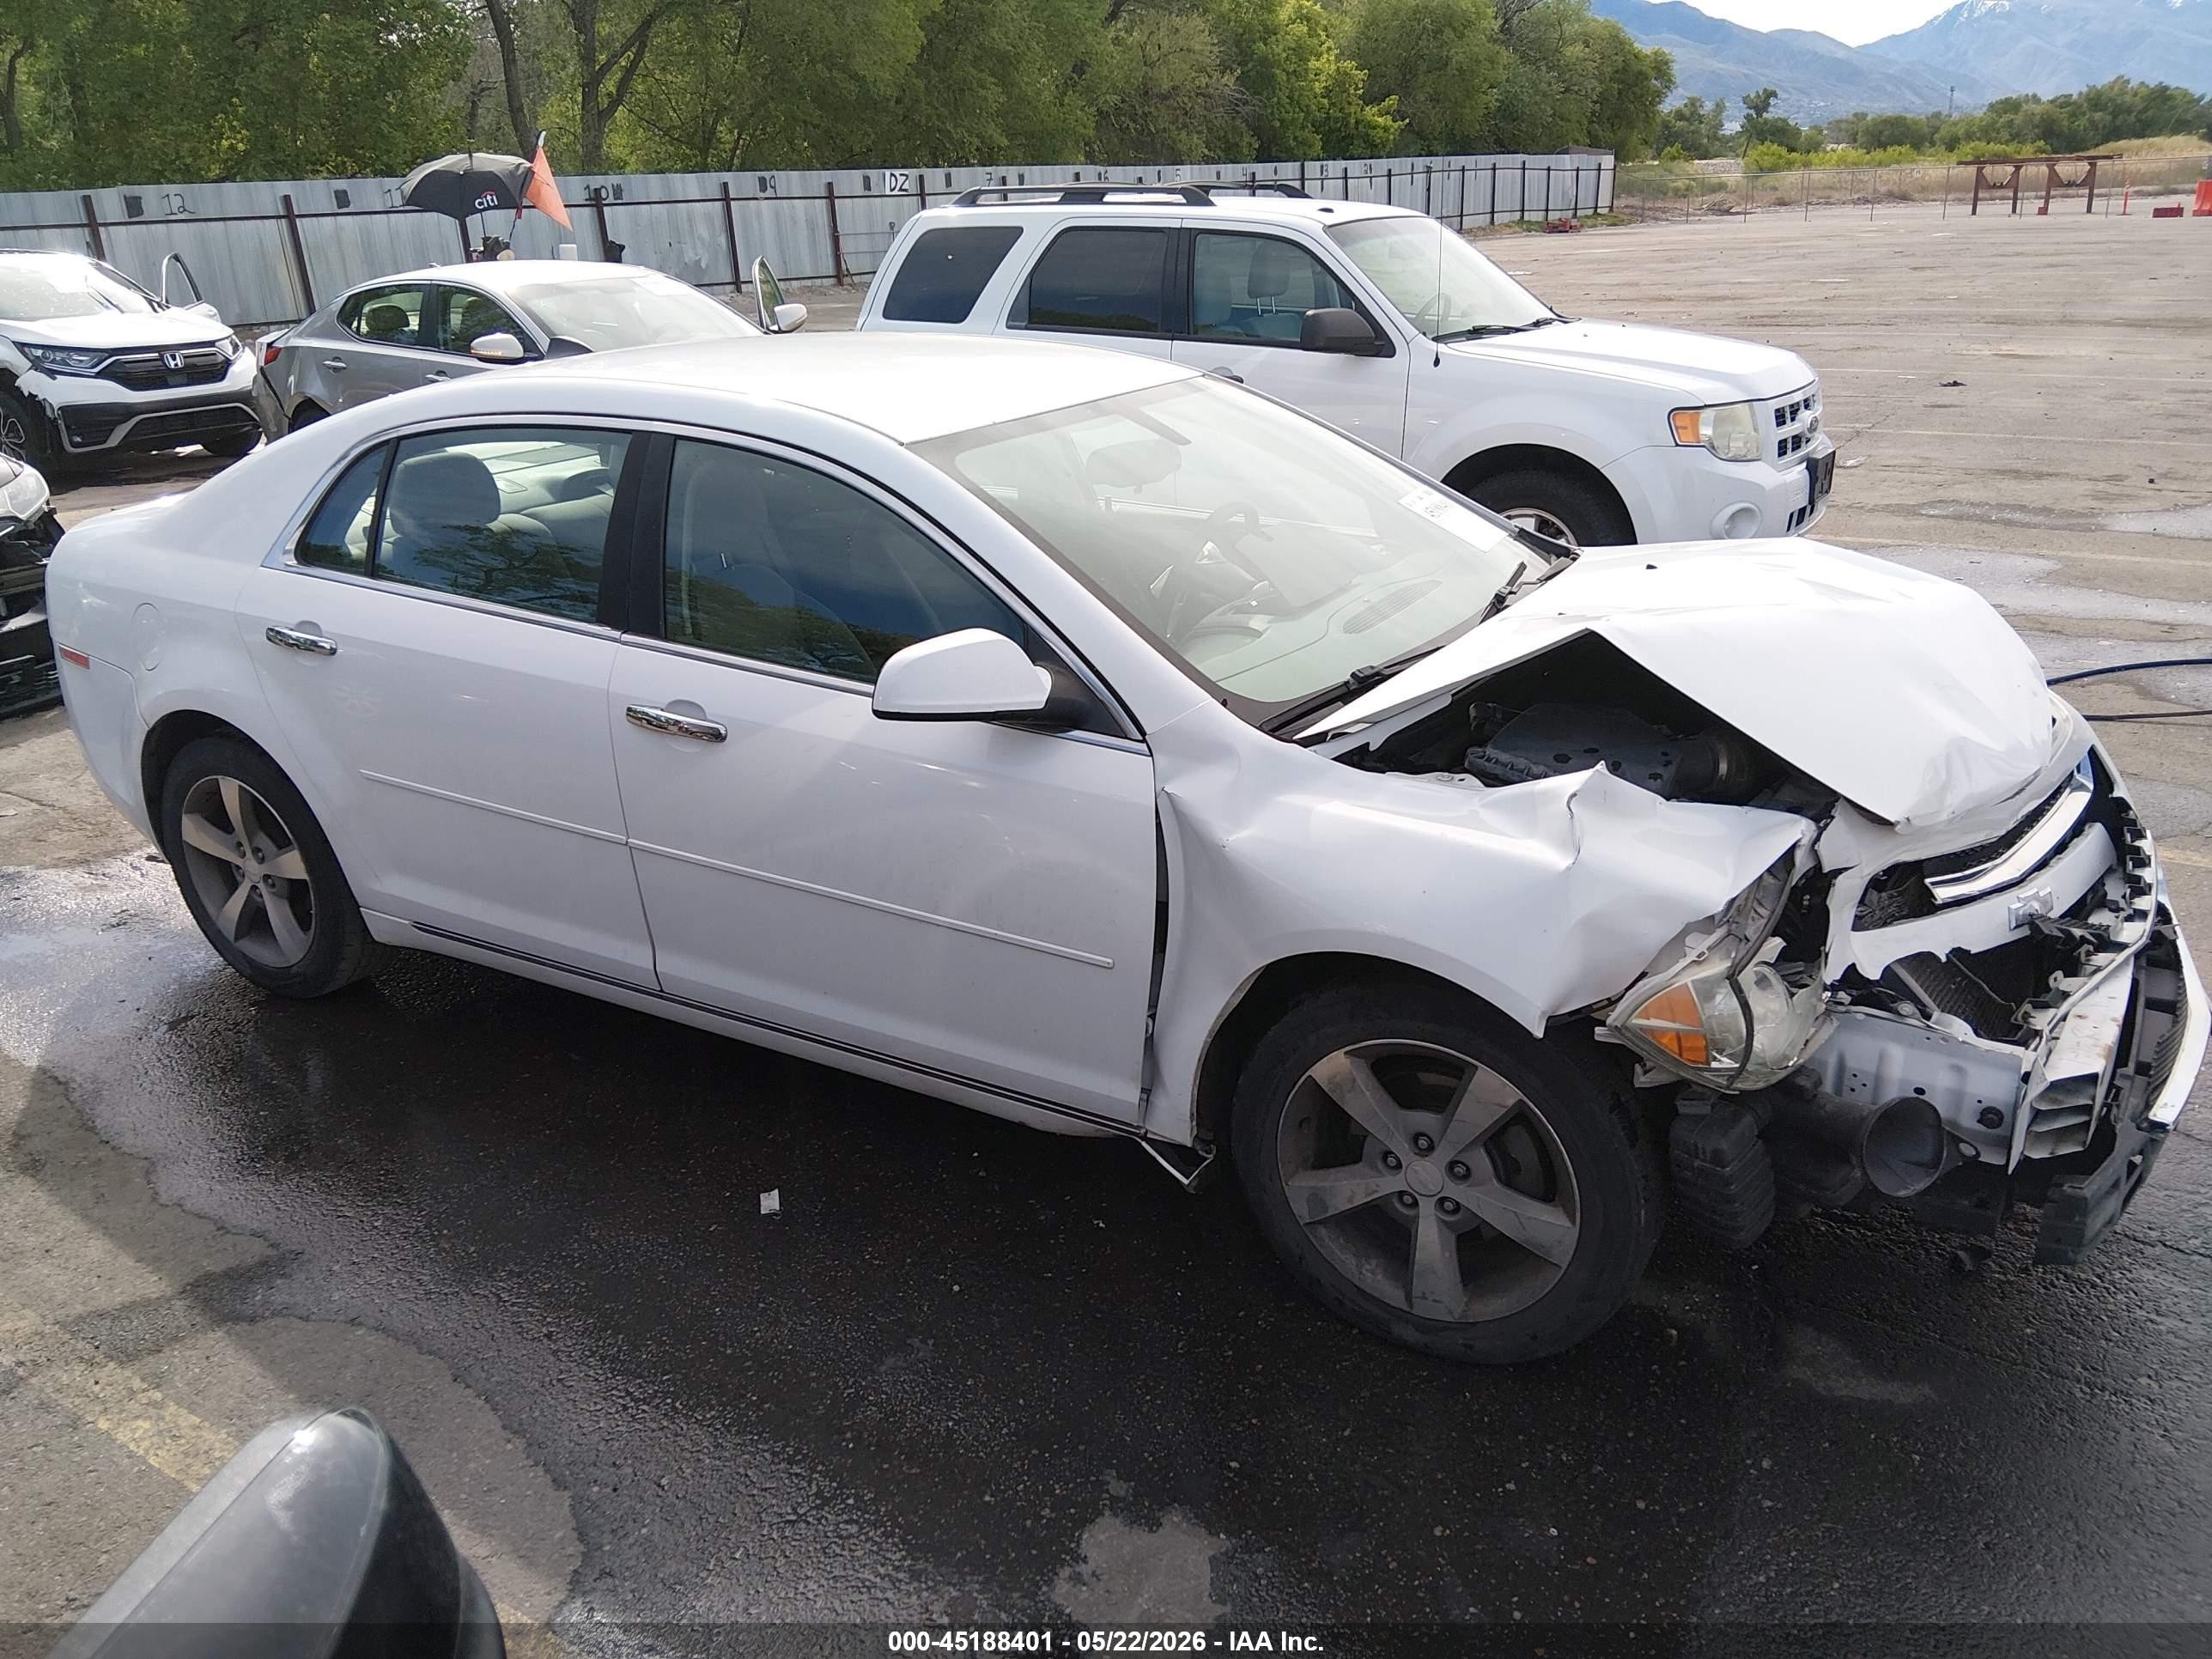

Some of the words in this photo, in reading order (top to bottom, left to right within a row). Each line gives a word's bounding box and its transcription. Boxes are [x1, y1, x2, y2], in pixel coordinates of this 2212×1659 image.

[985, 172, 994, 187] 7
[161, 193, 196, 216] 12
[474, 193, 498, 210] citi
